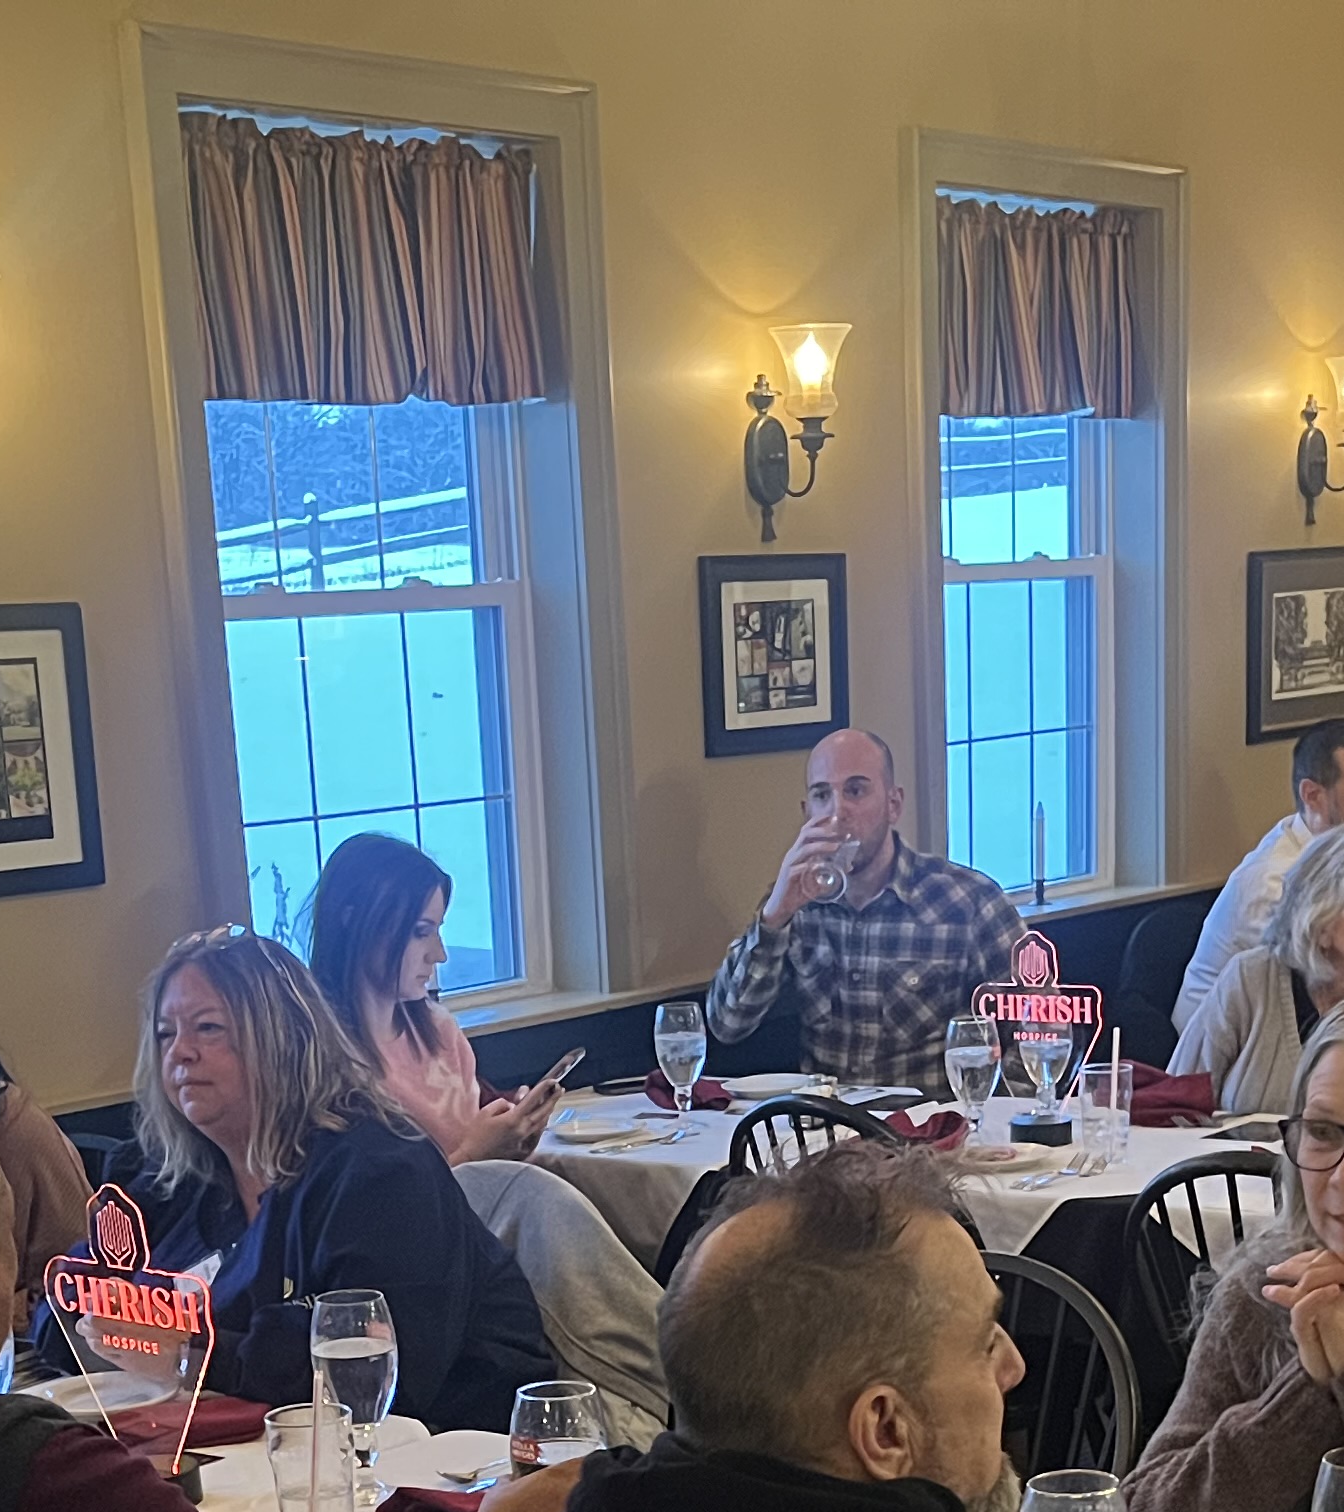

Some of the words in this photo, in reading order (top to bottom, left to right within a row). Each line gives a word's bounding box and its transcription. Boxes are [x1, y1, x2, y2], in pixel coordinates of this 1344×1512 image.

[978, 992, 1093, 1024] CHERISH
[54, 1272, 202, 1334] CHERISH
[102, 1334, 160, 1356] HOSPICE
